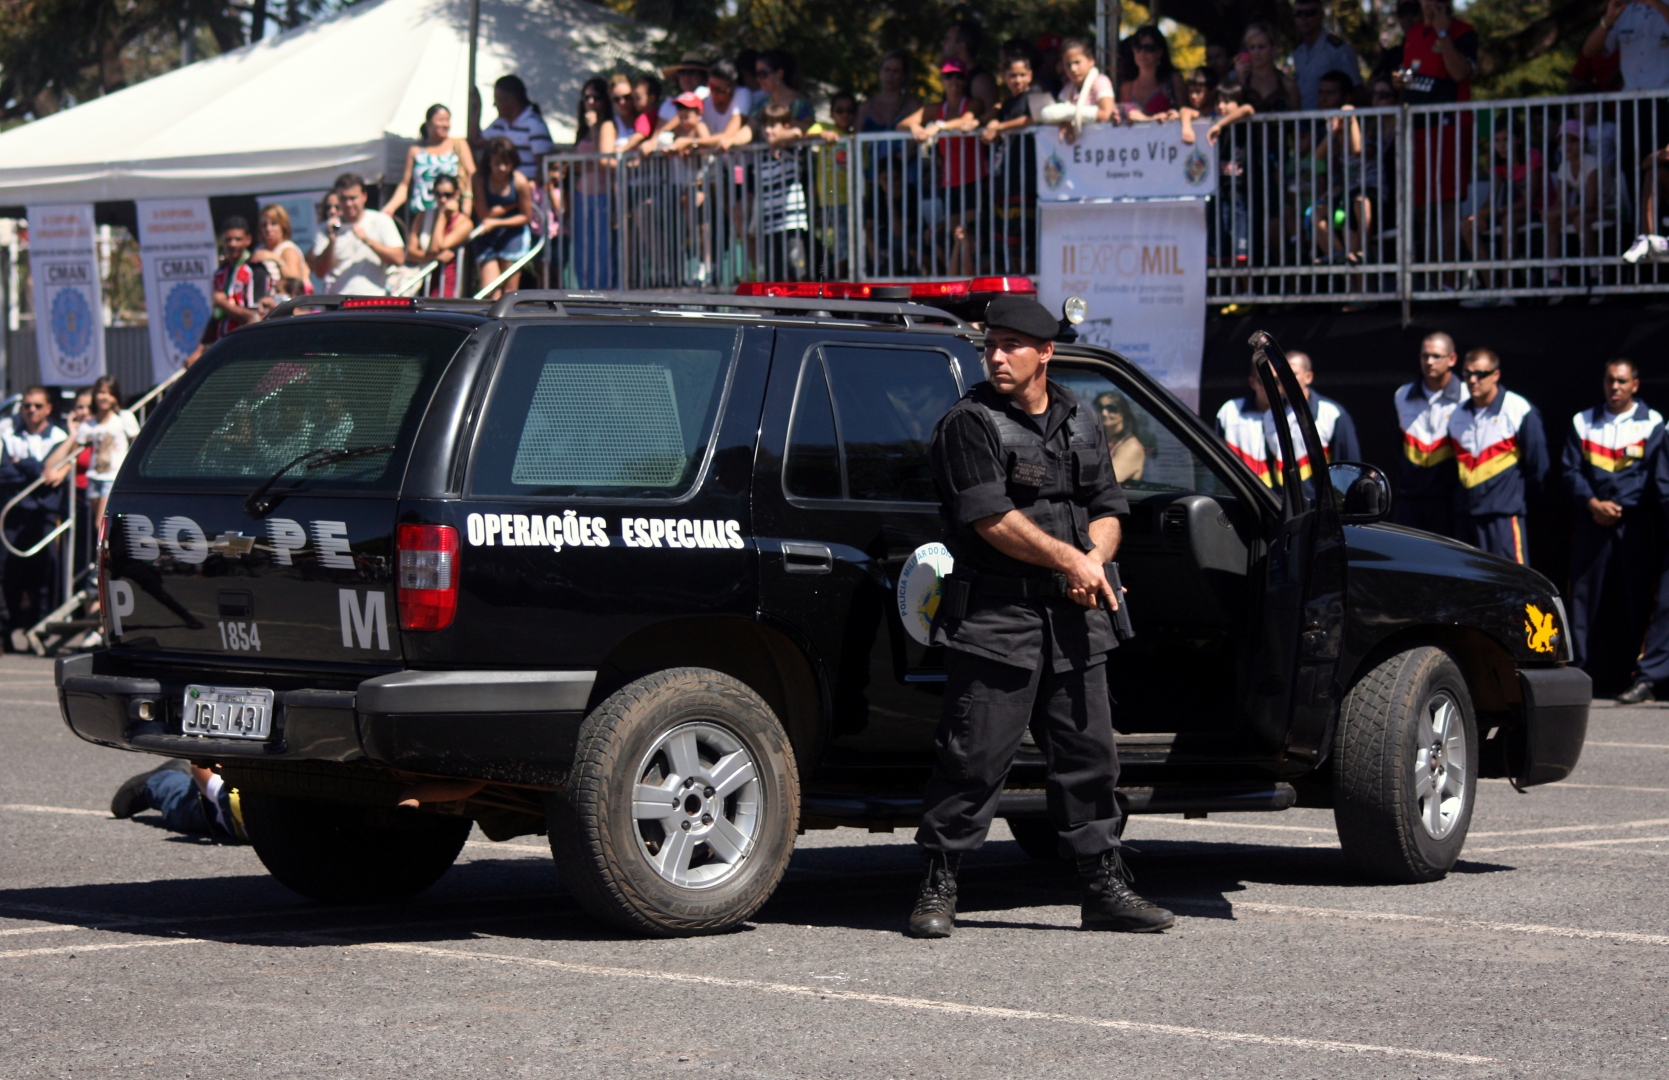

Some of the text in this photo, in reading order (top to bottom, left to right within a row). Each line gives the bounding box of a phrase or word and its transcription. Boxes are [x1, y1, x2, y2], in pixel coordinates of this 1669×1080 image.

[1073, 142, 1178, 167] Espaço Vip
[48, 265, 87, 280] CMAN
[162, 260, 204, 277] CMAN
[467, 509, 745, 552] OPERAÇÕES ESPECIAIS
[898, 580, 908, 617] POLÍCIA
[903, 551, 927, 578] MILITAR
[928, 547, 939, 555] DO
[109, 580, 390, 651] P M
[218, 621, 261, 651] 1854
